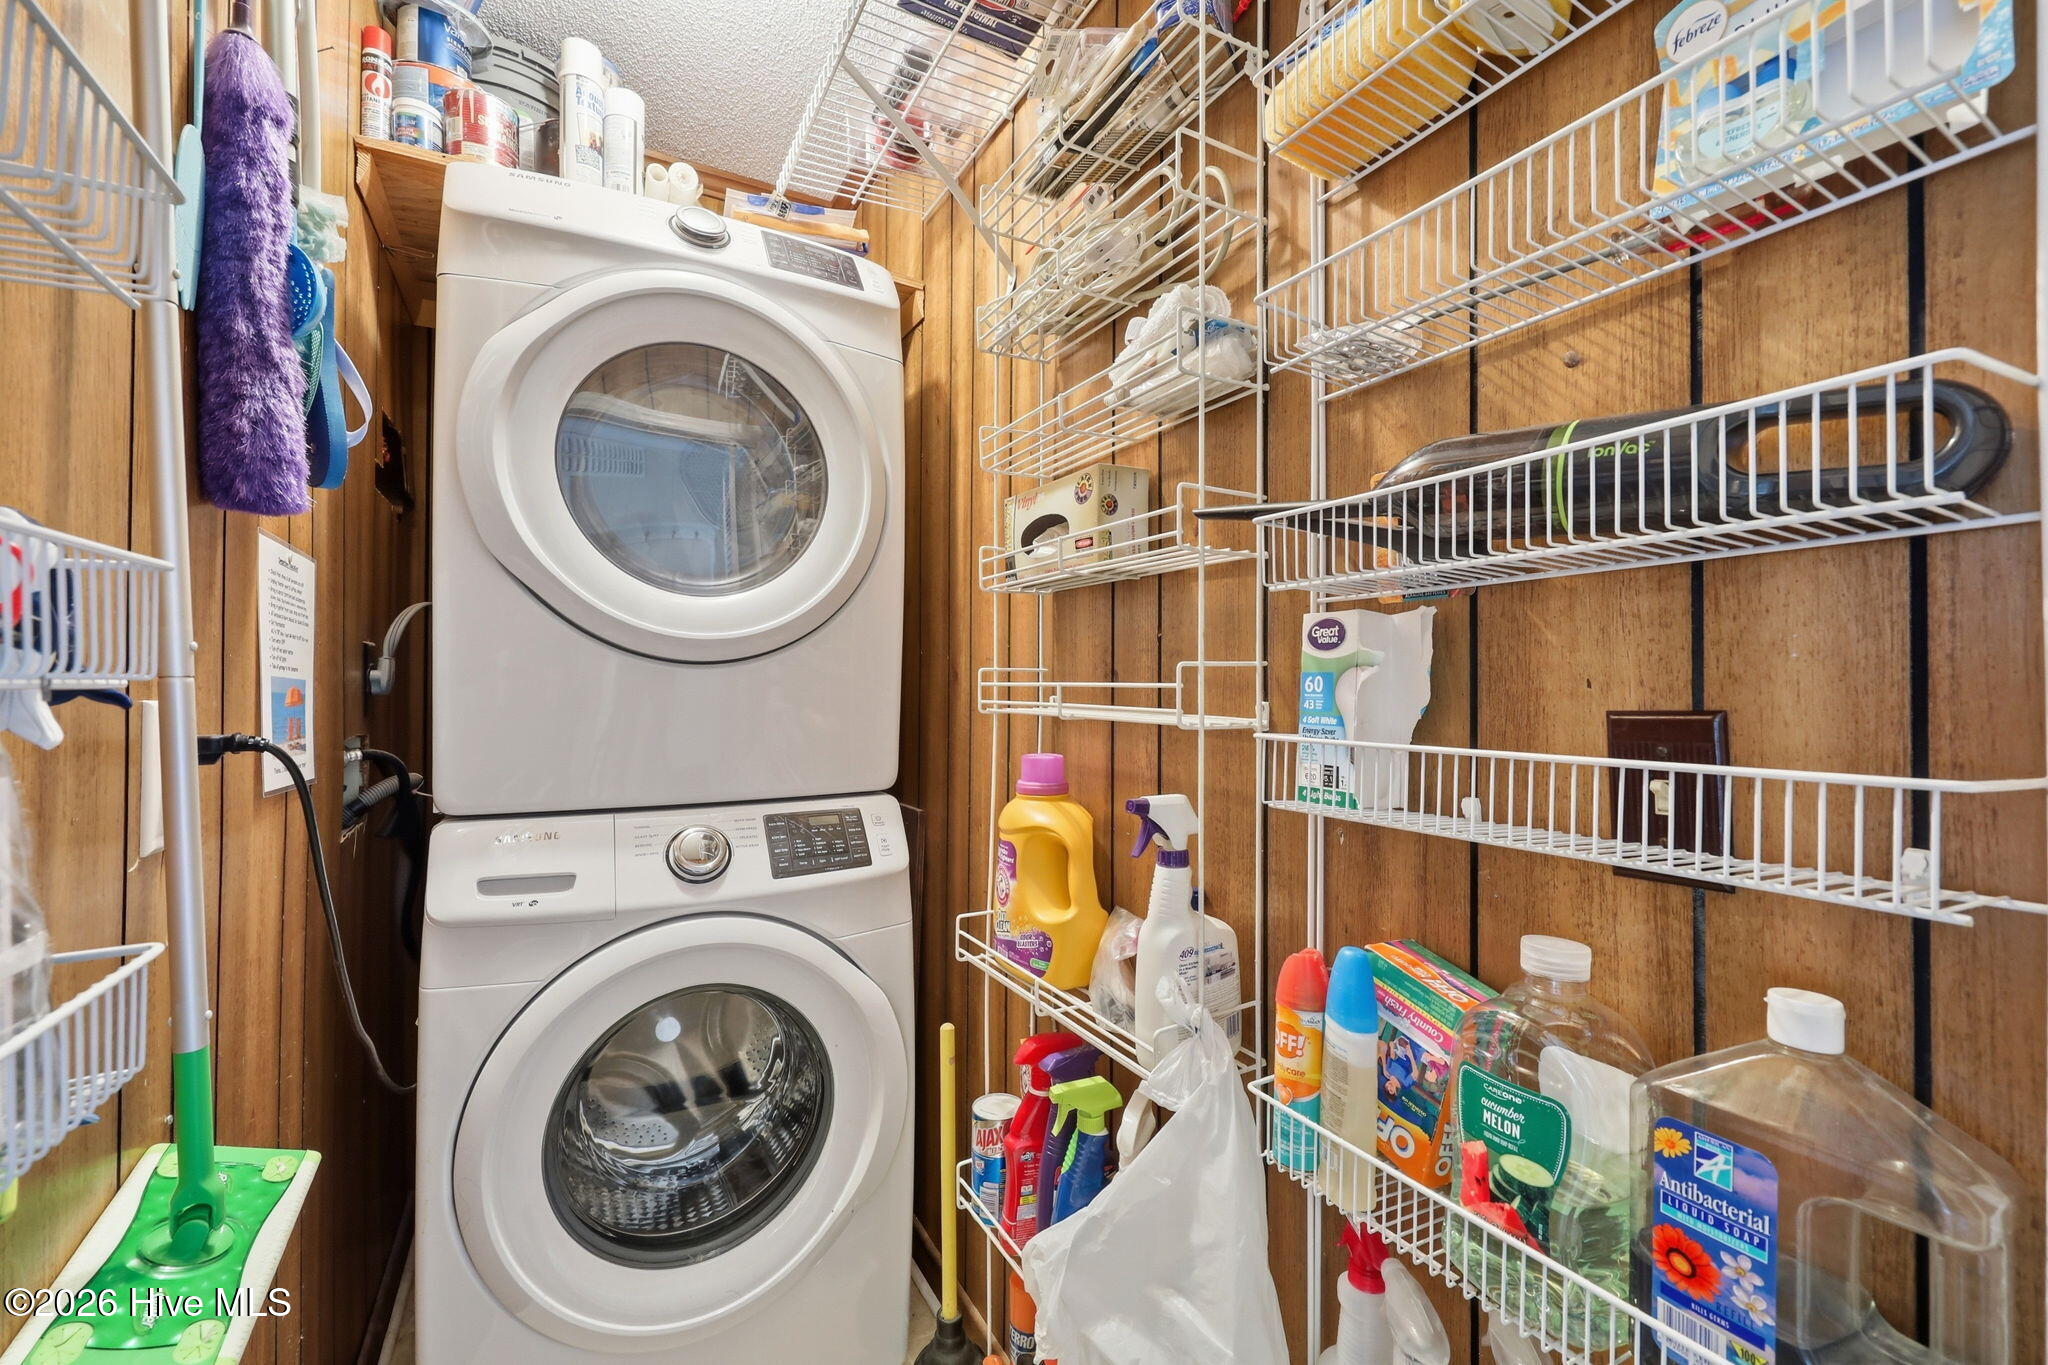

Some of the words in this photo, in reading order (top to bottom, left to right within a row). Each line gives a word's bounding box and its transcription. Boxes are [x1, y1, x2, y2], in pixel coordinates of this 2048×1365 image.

[1673, 13, 1722, 55] febreze
[508, 172, 572, 188] SAMSUNG
[1311, 625, 1340, 638] Great
[1304, 675, 1324, 693] 60
[1303, 699, 1315, 710] 43
[1302, 726, 1321, 736] Energy
[494, 831, 561, 845] SAMSUNG
[1179, 947, 1195, 960] 409
[1383, 994, 1408, 1017] Fresh
[1408, 1011, 1445, 1044] Country
[1481, 1096, 1526, 1124] cucumber
[1483, 1108, 1521, 1140] MELON
[975, 1126, 1004, 1151] AJAX
[1659, 1170, 1771, 1236] Antibacterial
[1667, 1195, 1715, 1226] LIQUID
[1724, 1222, 1760, 1246] SOAP
[1690, 1302, 1708, 1316] KILLS
[1708, 1312, 1730, 1329] GERMS
